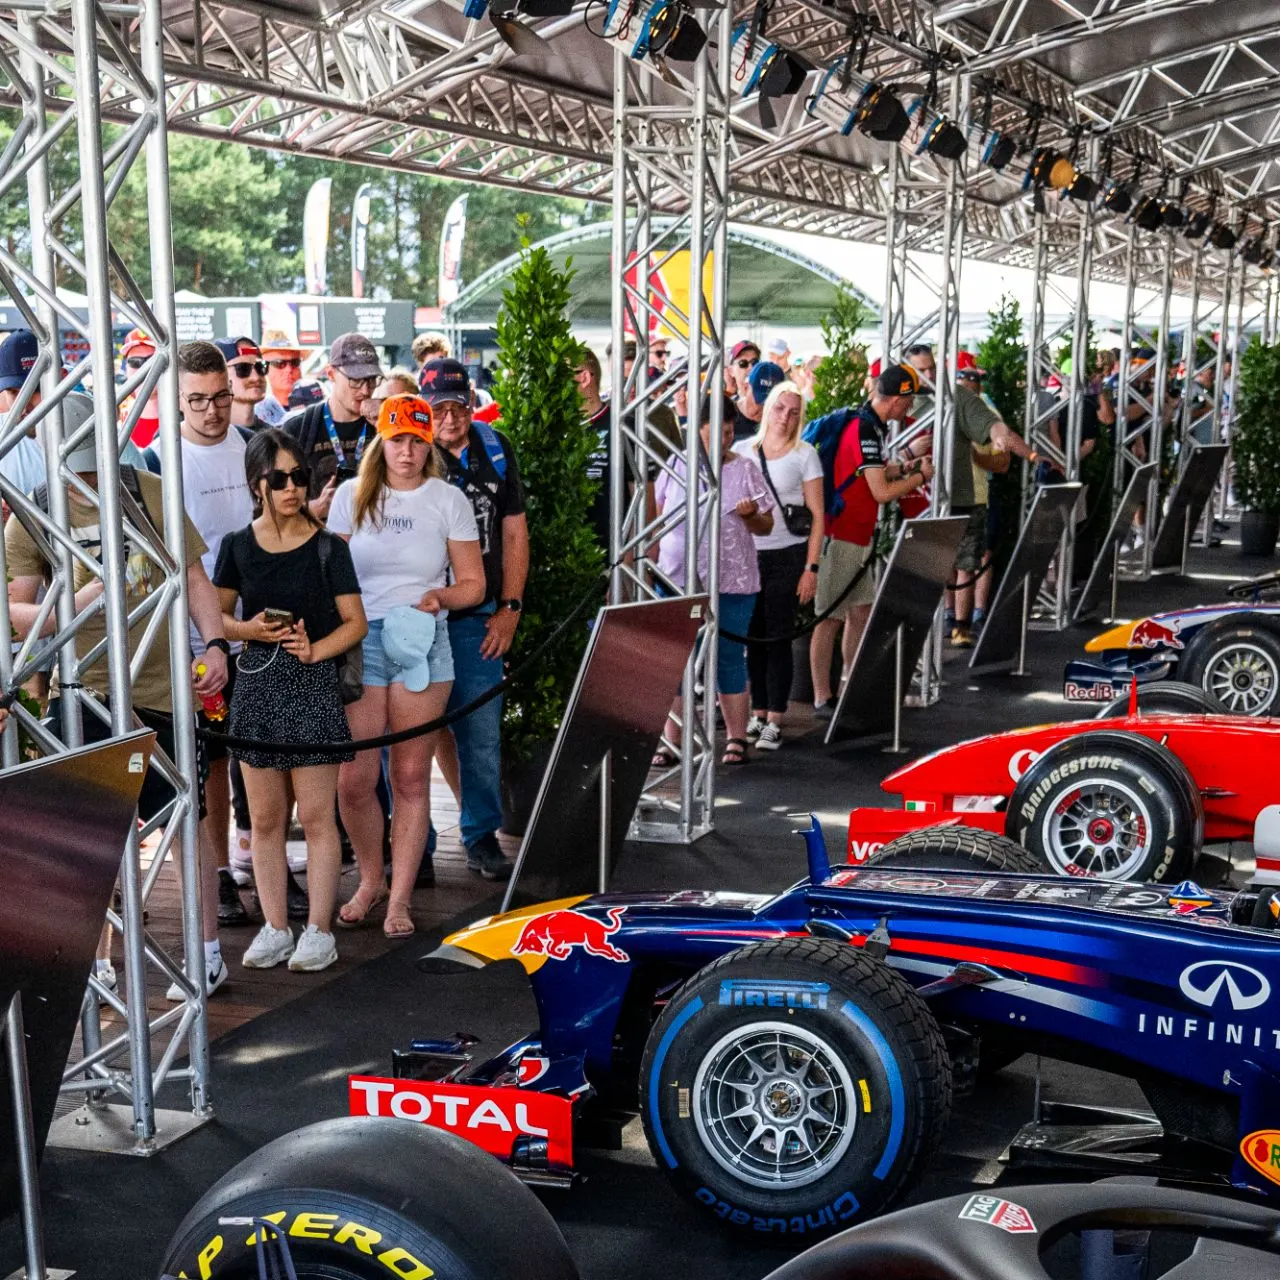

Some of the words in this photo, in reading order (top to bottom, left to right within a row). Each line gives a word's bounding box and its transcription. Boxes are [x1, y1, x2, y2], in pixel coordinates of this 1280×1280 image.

[383, 517, 415, 530] TOMMY
[1065, 683, 1100, 700] Red
[1021, 755, 1123, 823] BRIDGESTONE
[720, 980, 831, 1010] PIRELLI
[350, 1080, 549, 1136] TOTAL
[966, 1196, 998, 1223] TAG
[198, 1235, 224, 1280] P
